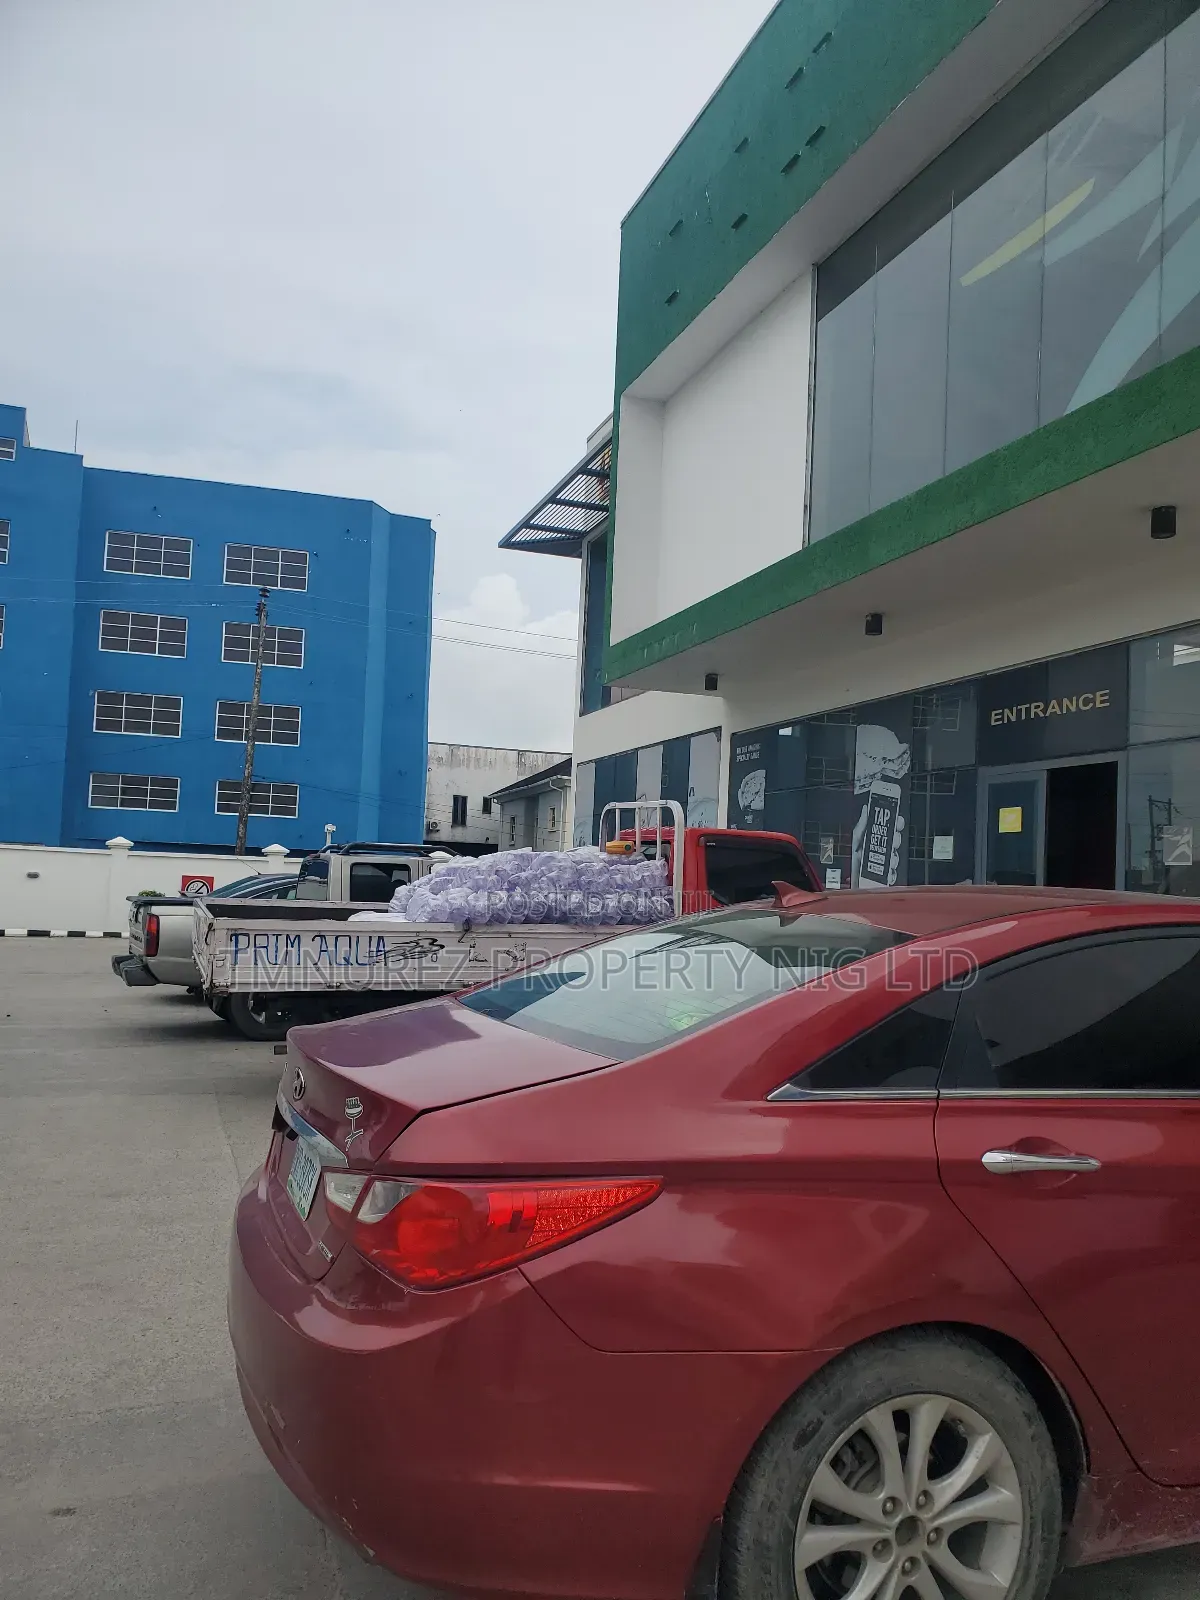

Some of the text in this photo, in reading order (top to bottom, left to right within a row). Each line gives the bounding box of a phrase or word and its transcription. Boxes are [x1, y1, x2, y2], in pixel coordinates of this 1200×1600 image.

[990, 689, 1110, 726] ENTRANCE
[870, 833, 881, 846] GET
[311, 934, 388, 967] AQUA
